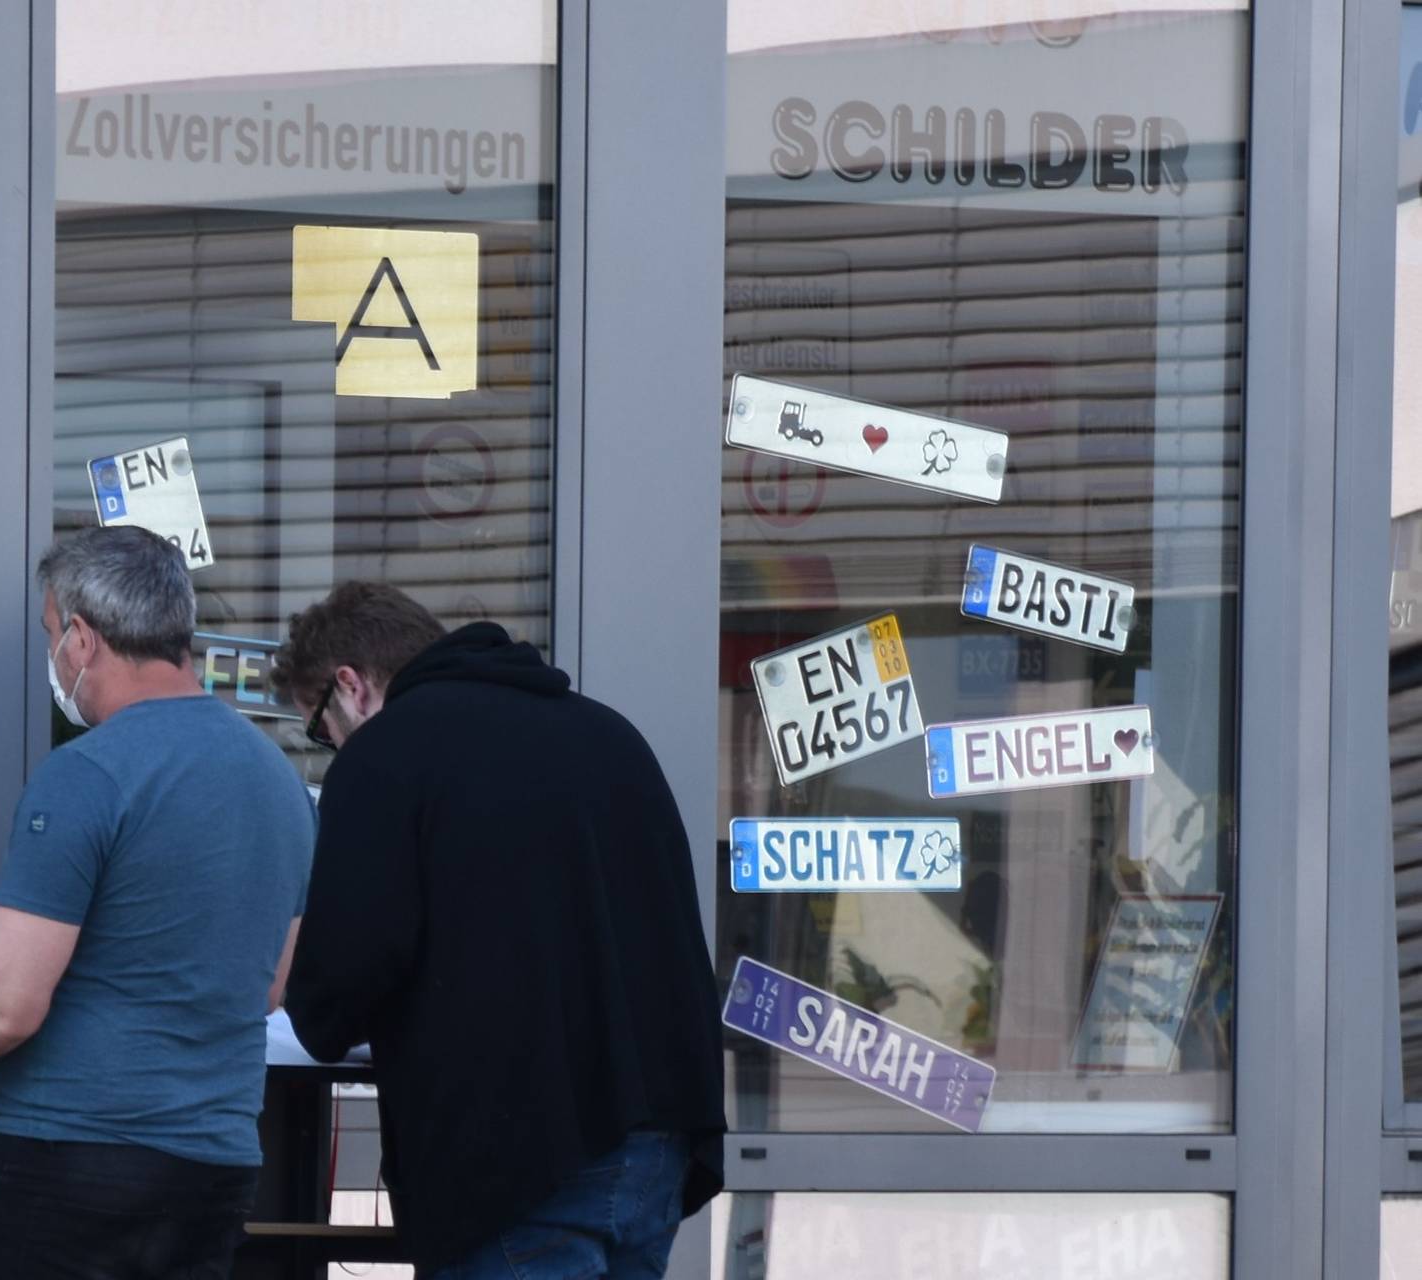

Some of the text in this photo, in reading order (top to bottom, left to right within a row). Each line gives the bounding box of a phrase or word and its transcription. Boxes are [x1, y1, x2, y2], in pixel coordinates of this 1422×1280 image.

[65, 93, 526, 195] Zollversicherungen
[769, 96, 1191, 197] SCHILDER
[335, 256, 442, 371] A
[122, 447, 170, 491] EN
[106, 496, 119, 513] D
[998, 563, 1117, 642] BASTI
[798, 638, 864, 704] EN
[884, 657, 902, 675] 10
[777, 679, 911, 773] 04567
[965, 722, 1112, 785] ENGEL
[763, 829, 918, 882] SCHATZ
[755, 994, 774, 1014] 02
[788, 994, 935, 1101] SARAH
